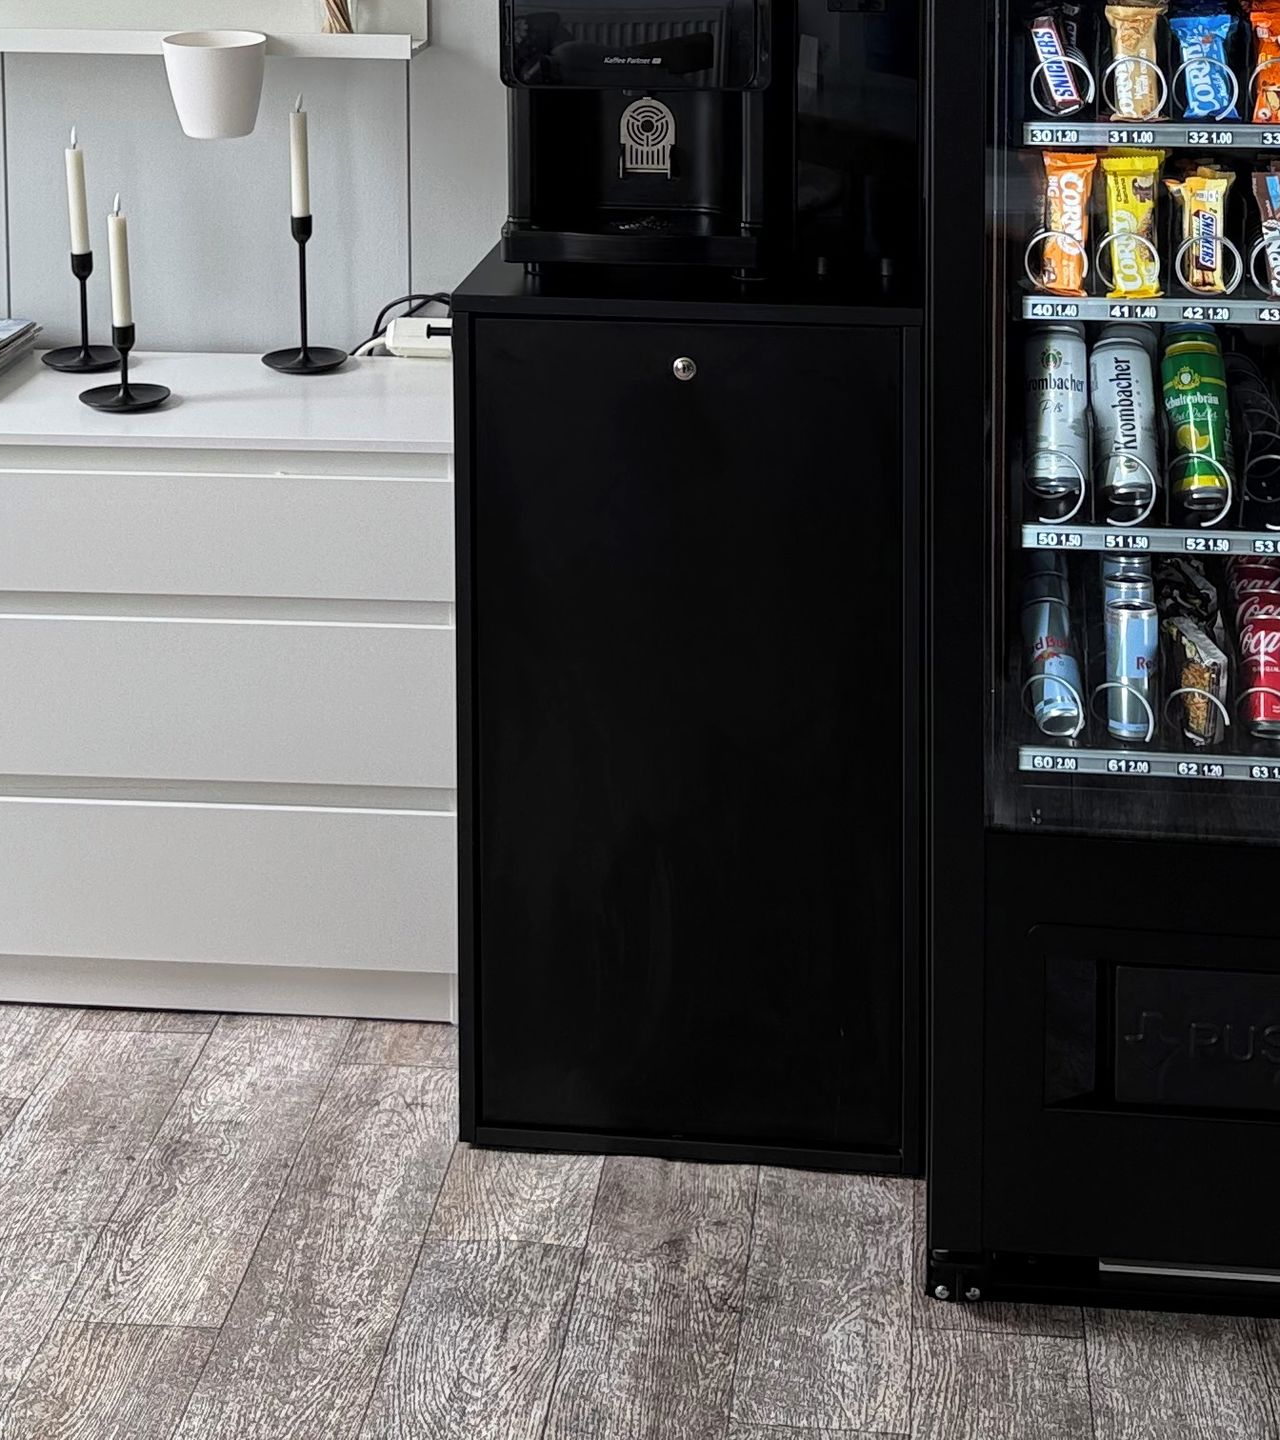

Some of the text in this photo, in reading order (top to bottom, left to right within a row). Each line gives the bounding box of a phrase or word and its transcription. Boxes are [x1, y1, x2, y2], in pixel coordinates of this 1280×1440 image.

[1032, 131, 1077, 142] 30 1.20
[1109, 132, 1153, 143] 31 1.00
[1189, 132, 1232, 144] 32 1.00
[1032, 305, 1077, 317] 40 1.40
[1111, 306, 1156, 318] 41 1.40
[1183, 307, 1229, 320] 42 1.20
[1259, 309, 1280, 320] 43
[1109, 357, 1138, 450] Krombacher
[1038, 534, 1081, 546] 50 1.50
[1106, 536, 1148, 548] 51 1.50
[1186, 539, 1230, 551] 52 1.50
[1254, 541, 1274, 553] 53
[1034, 757, 1076, 769] 60 2.00
[1108, 760, 1149, 773] 61 2.00
[1179, 763, 1223, 776] 62 1.20
[1252, 766, 1269, 777] 63
